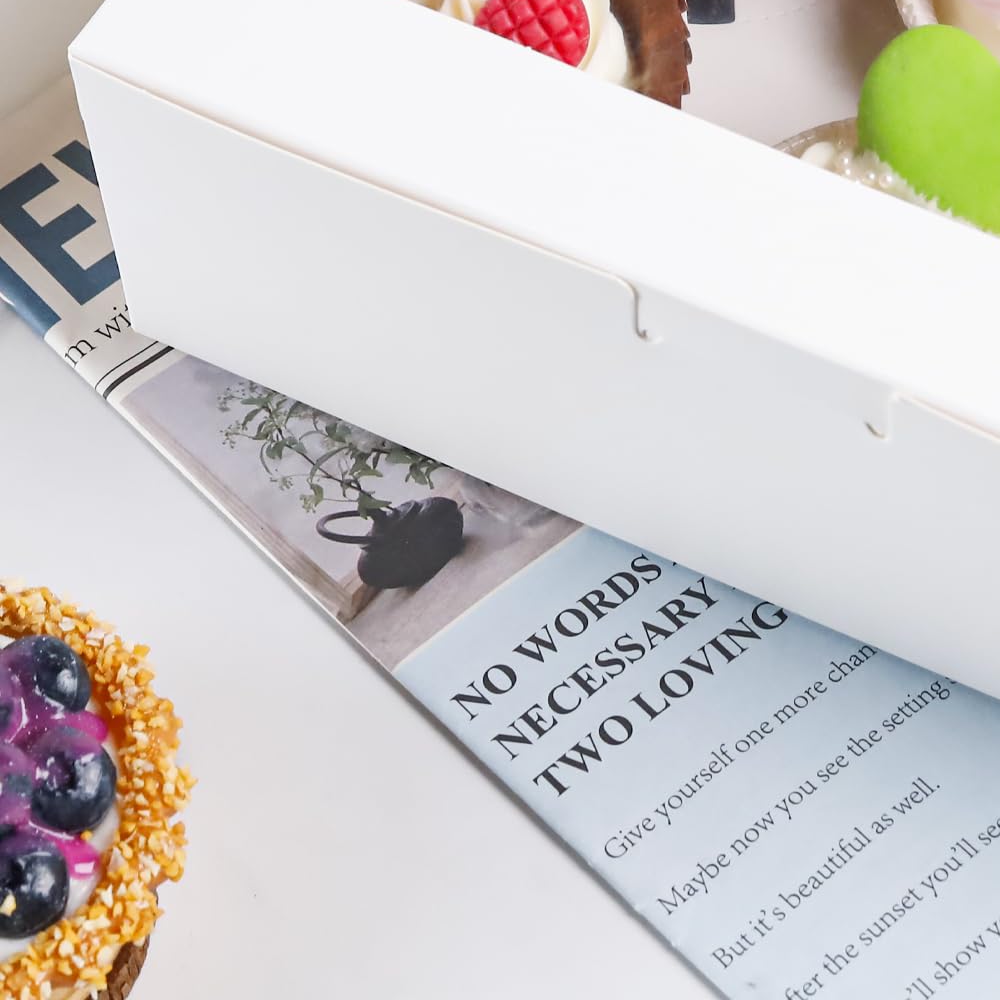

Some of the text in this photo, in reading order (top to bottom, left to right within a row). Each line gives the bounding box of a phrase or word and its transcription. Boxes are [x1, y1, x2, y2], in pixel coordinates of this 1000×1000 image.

[94, 304, 132, 339] wi
[450, 553, 662, 721] NO WORDS
[490, 576, 719, 761] NECESSARY
[532, 601, 789, 797] TWO LOVING
[604, 816, 656, 859] Give
[654, 743, 736, 826] yourself
[735, 721, 774, 753] one
[773, 681, 828, 725] more
[657, 679, 951, 915] Maybe now you see the setting
[712, 777, 941, 969] But it's beautiful as well.
[823, 942, 860, 976] the
[859, 887, 923, 946] sunset
[920, 838, 979, 898] you'll
[934, 933, 987, 984] show
